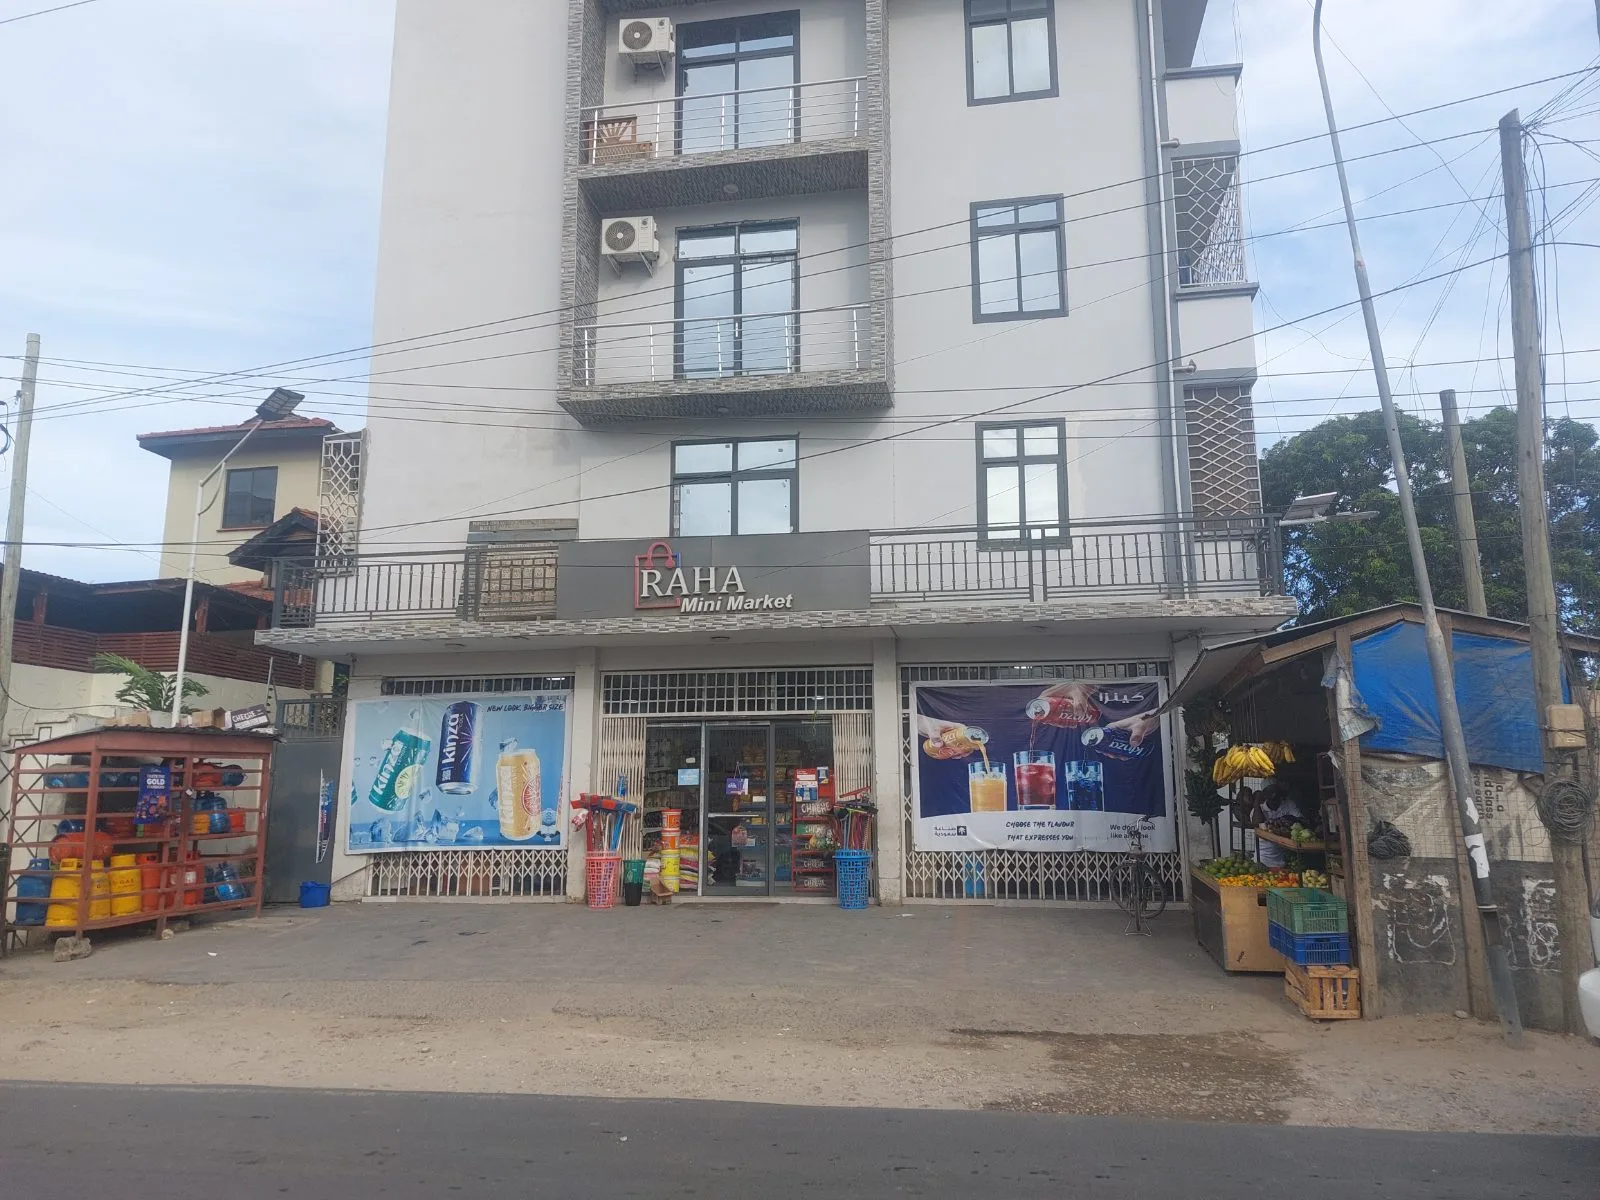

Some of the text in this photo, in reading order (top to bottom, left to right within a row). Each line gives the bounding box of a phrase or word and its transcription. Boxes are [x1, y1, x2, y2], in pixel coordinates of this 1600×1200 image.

[640, 565, 746, 597] RAHA
[680, 593, 793, 613] Mini Market
[486, 704, 503, 712] NEW
[522, 703, 547, 712] BIGGER
[548, 703, 564, 711] SIZE
[441, 713, 460, 764] kinza
[146, 778, 165, 786] GOLD
[1047, 820, 1075, 828] FLAVOUR
